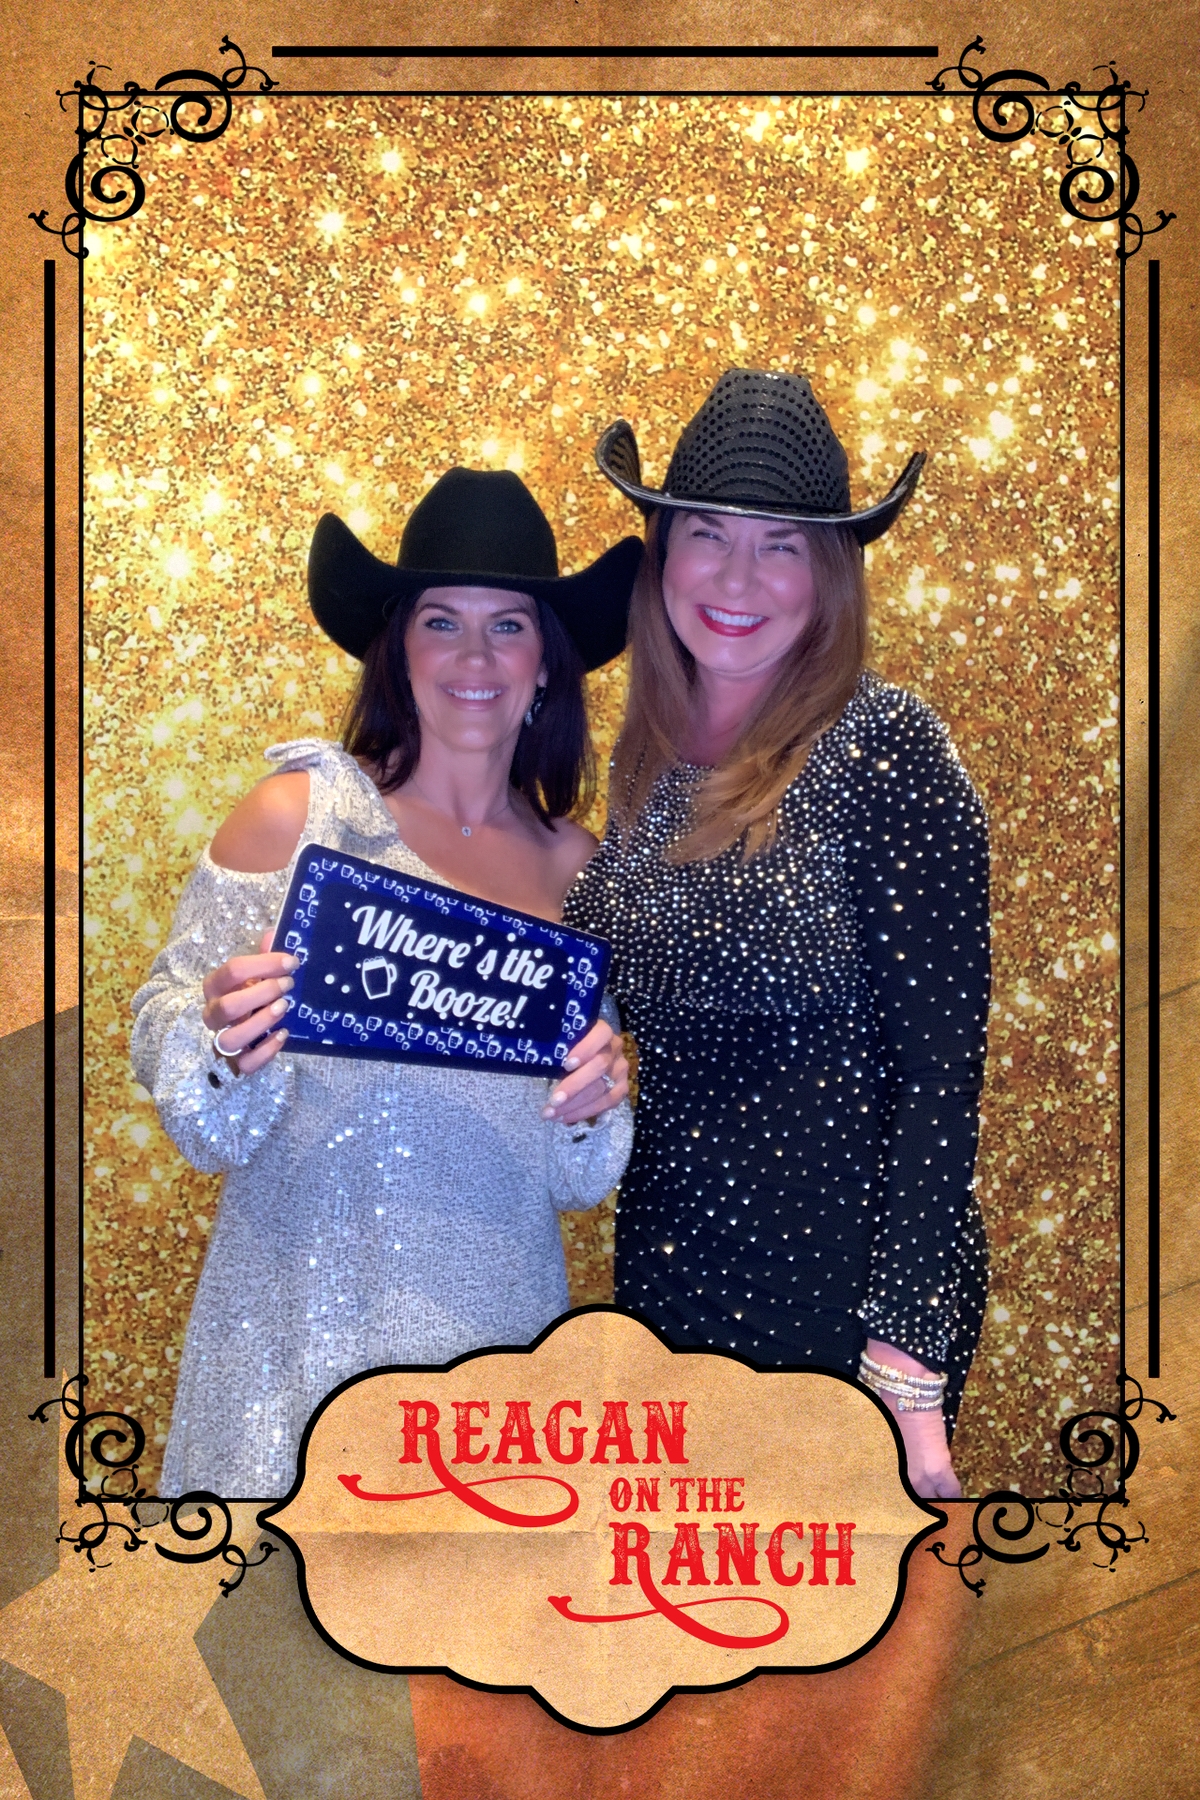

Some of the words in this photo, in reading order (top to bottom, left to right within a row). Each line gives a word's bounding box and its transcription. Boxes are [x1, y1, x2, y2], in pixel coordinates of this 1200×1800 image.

[351, 905, 498, 981] Where's
[499, 946, 555, 990] the
[407, 969, 528, 1029] Booze!
